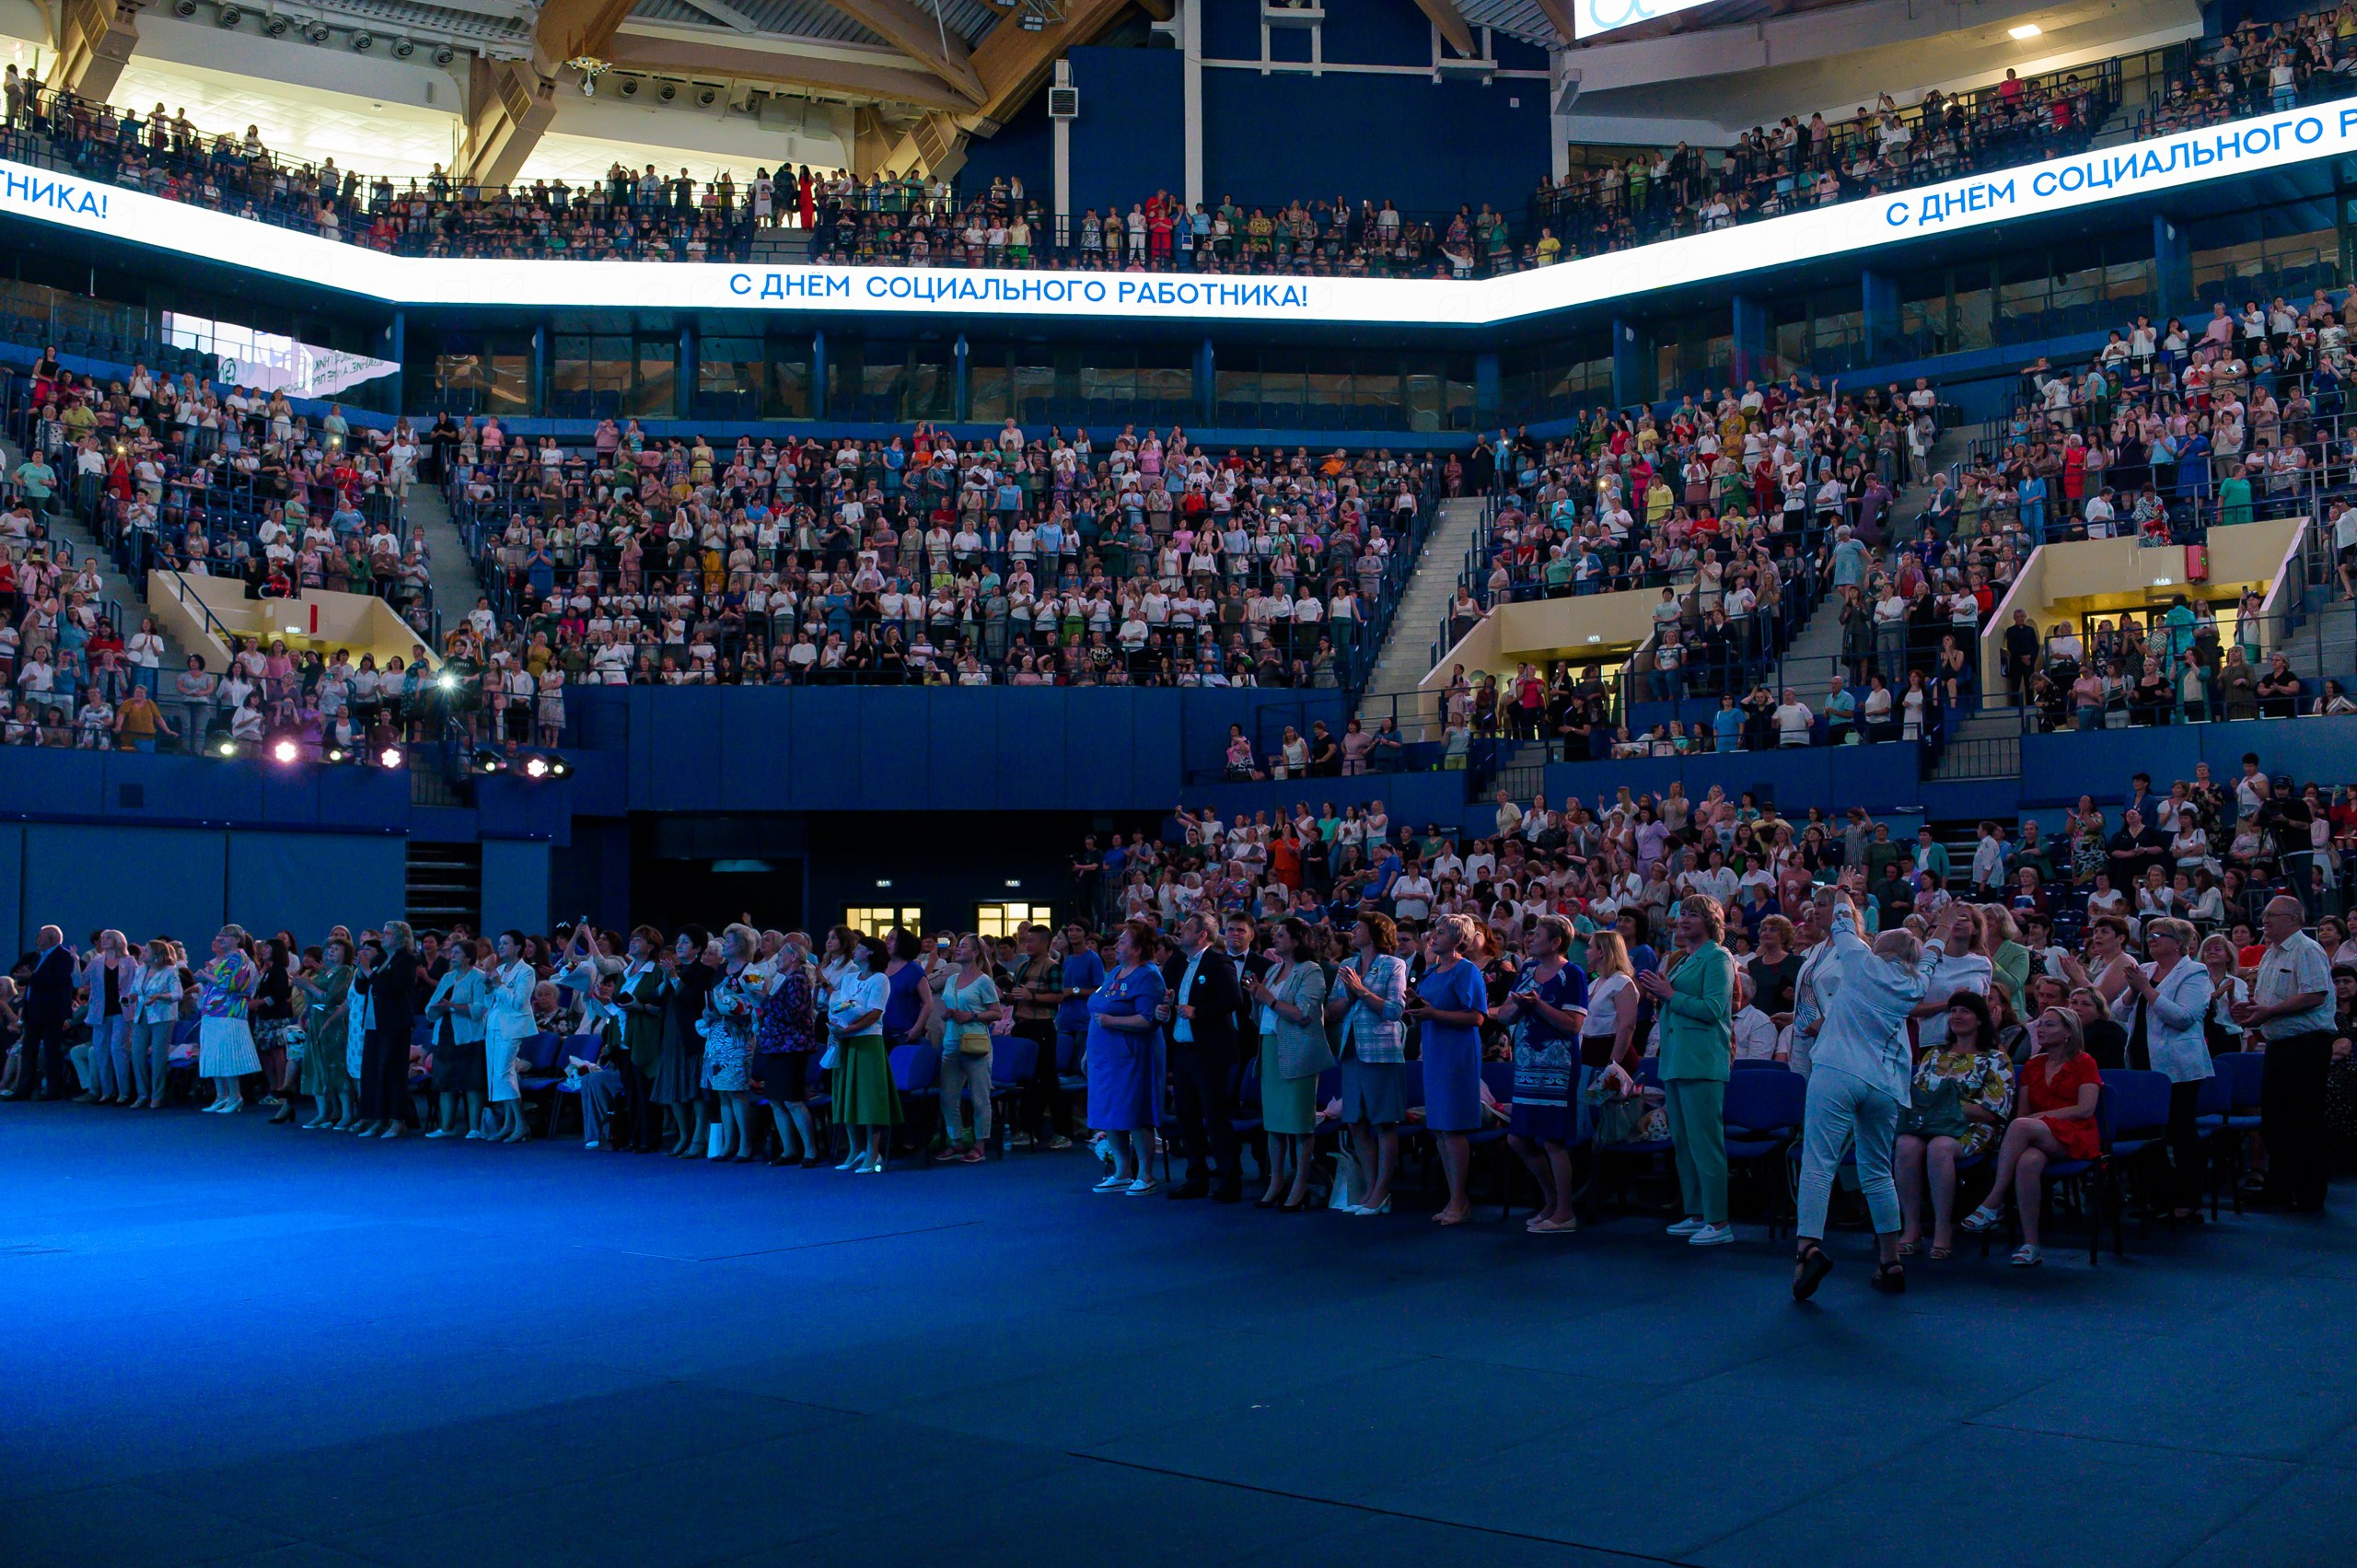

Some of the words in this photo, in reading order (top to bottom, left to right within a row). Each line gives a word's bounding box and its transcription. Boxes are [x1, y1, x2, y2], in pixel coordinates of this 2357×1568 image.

[1886, 202, 1910, 226] С
[1918, 179, 2015, 226] ДНЁМ
[2032, 117, 2324, 197] СОЦИАЛЬНОГО
[729, 273, 752, 296] С
[760, 272, 850, 300] ДНЁМ
[865, 275, 1107, 304] СОЦИАЛЬНОГО
[1118, 281, 1307, 308] РАБОТНИКА!
